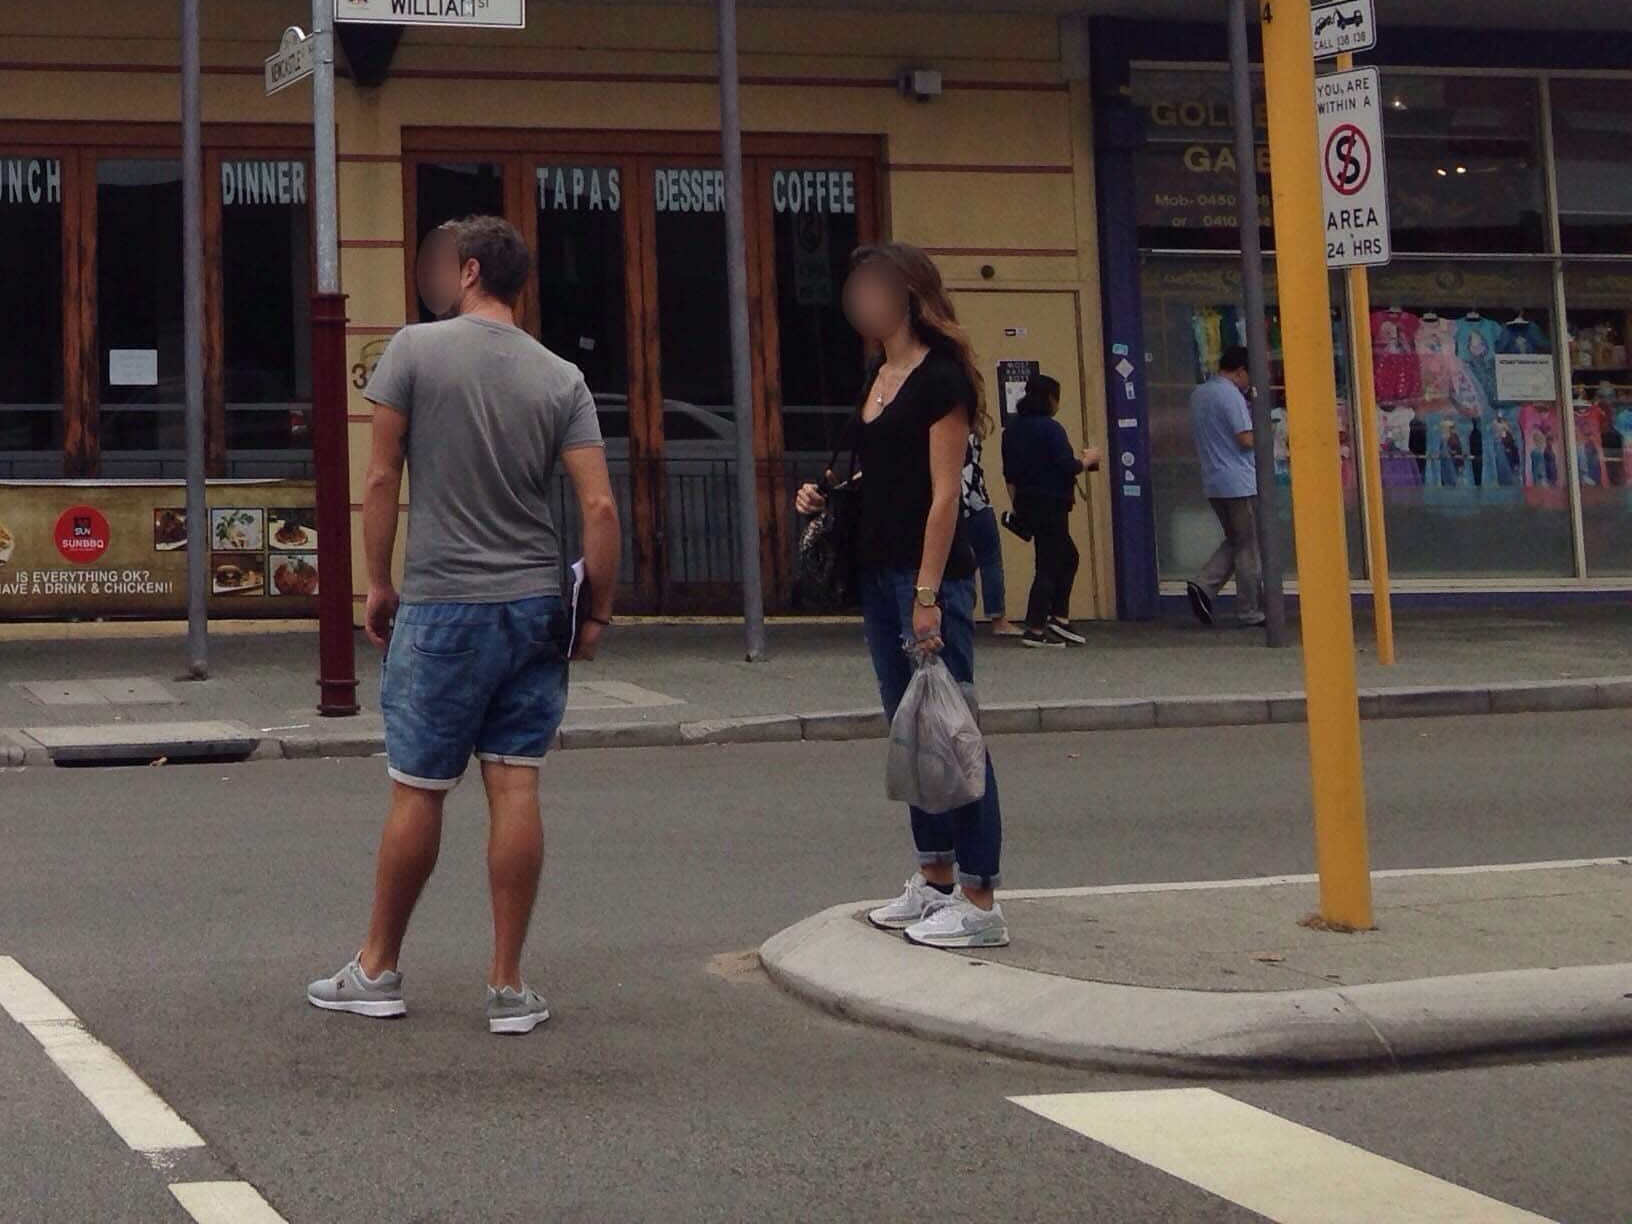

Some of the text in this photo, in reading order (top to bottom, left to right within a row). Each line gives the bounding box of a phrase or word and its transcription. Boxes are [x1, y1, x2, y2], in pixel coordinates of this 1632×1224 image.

[1318, 77, 1370, 96] YOU ARE
[1318, 97, 1371, 115] WITHIN A
[221, 161, 305, 204] DINNER
[537, 167, 620, 212] TAPAS
[655, 169, 727, 212] DESSER
[773, 171, 855, 213] COFFEE
[1327, 208, 1378, 230] AREA
[1327, 239, 1382, 258] 24 HRS
[62, 539, 104, 548] SUNBBQ
[16, 570, 150, 582] IS EVERYTHING OK?
[32, 583, 41, 594] A
[44, 583, 87, 594] DRINK
[91, 582, 99, 593] &
[104, 582, 173, 593] CHICKEN!!
